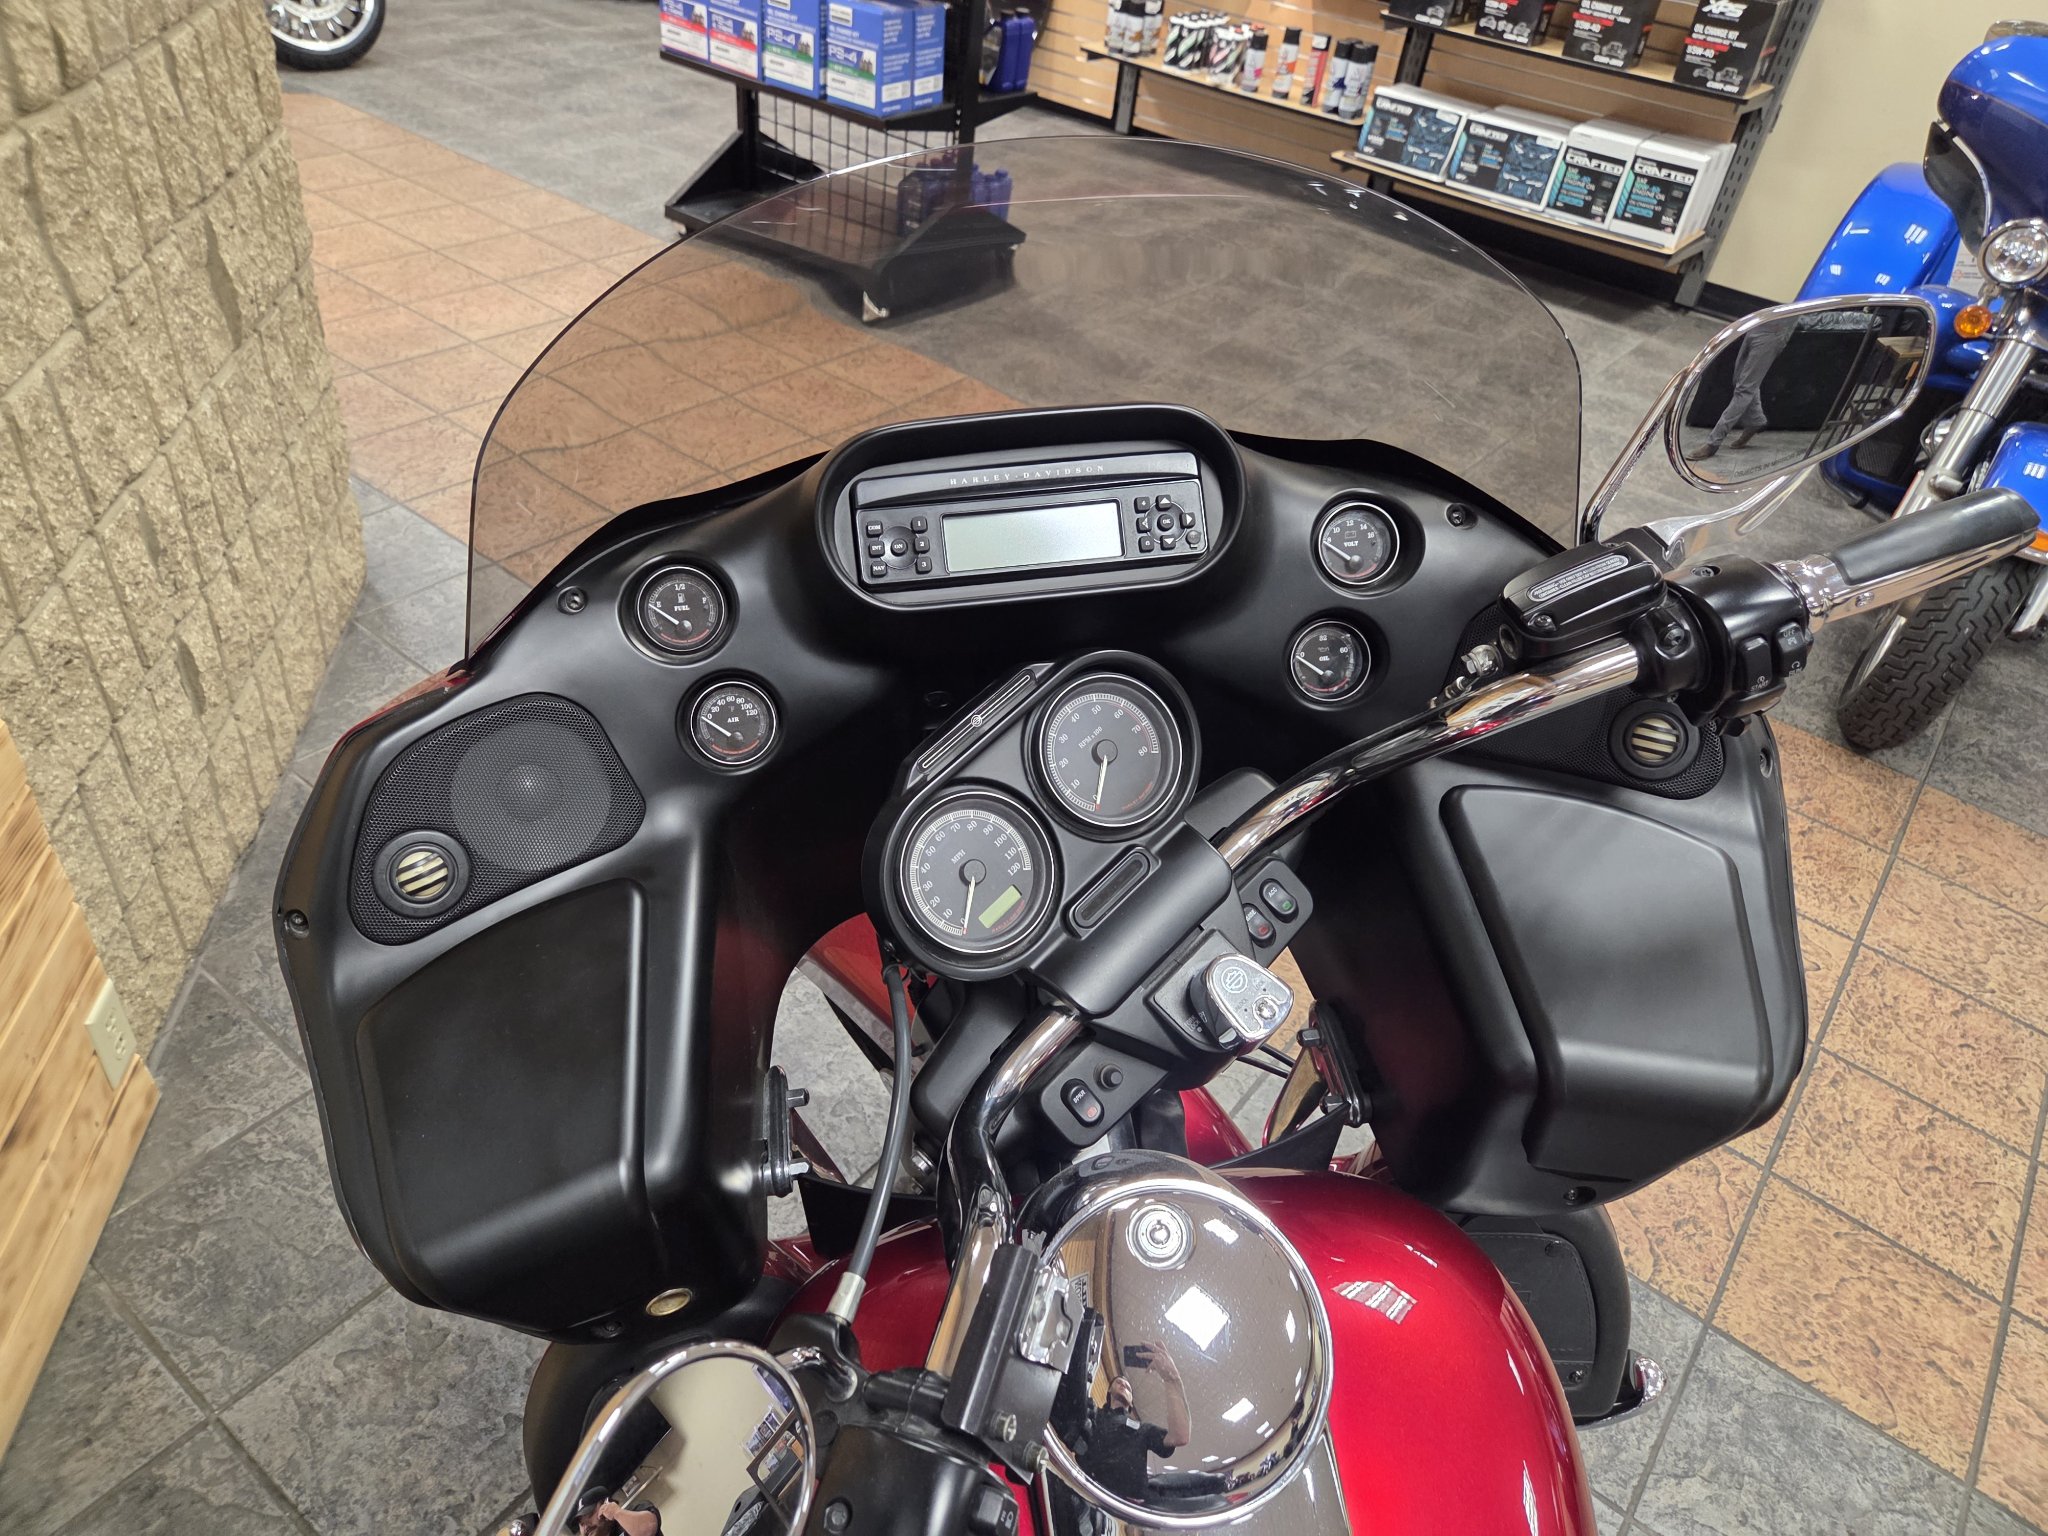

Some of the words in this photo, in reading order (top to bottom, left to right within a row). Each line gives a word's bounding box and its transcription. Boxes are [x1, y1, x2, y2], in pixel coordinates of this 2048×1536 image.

[1702, 0, 1749, 18] XPS
[1566, 153, 1623, 177] CRAFTED
[1634, 162, 1695, 187] CRAFTED
[1333, 526, 1340, 534] 10
[674, 583, 686, 591] 1/2
[1751, 680, 1768, 691] START
[716, 698, 726, 706] 40
[740, 703, 753, 711] 100
[1091, 704, 1102, 715] 50
[1113, 709, 1124, 719] 60
[1071, 712, 1080, 723] 40
[1131, 724, 1141, 734] 70
[1058, 733, 1069, 744] 30
[1078, 735, 1092, 749] RPM
[1094, 726, 1103, 736] 100
[1138, 745, 1148, 757] 80
[1059, 757, 1069, 769] 20
[1070, 779, 1080, 789] 10
[950, 822, 961, 833] 70
[966, 820, 978, 832] 80
[982, 824, 994, 836] 90
[934, 830, 946, 842] 60
[994, 833, 1008, 848] 100
[925, 845, 936, 857] 50
[951, 849, 966, 864] MPH
[1004, 847, 1017, 861] 110
[920, 862, 931, 874] 40
[1007, 862, 1021, 876] 120
[922, 880, 933, 892] 30
[1268, 887, 1278, 898] ACC
[930, 895, 940, 907] 20
[942, 908, 953, 919] 10
